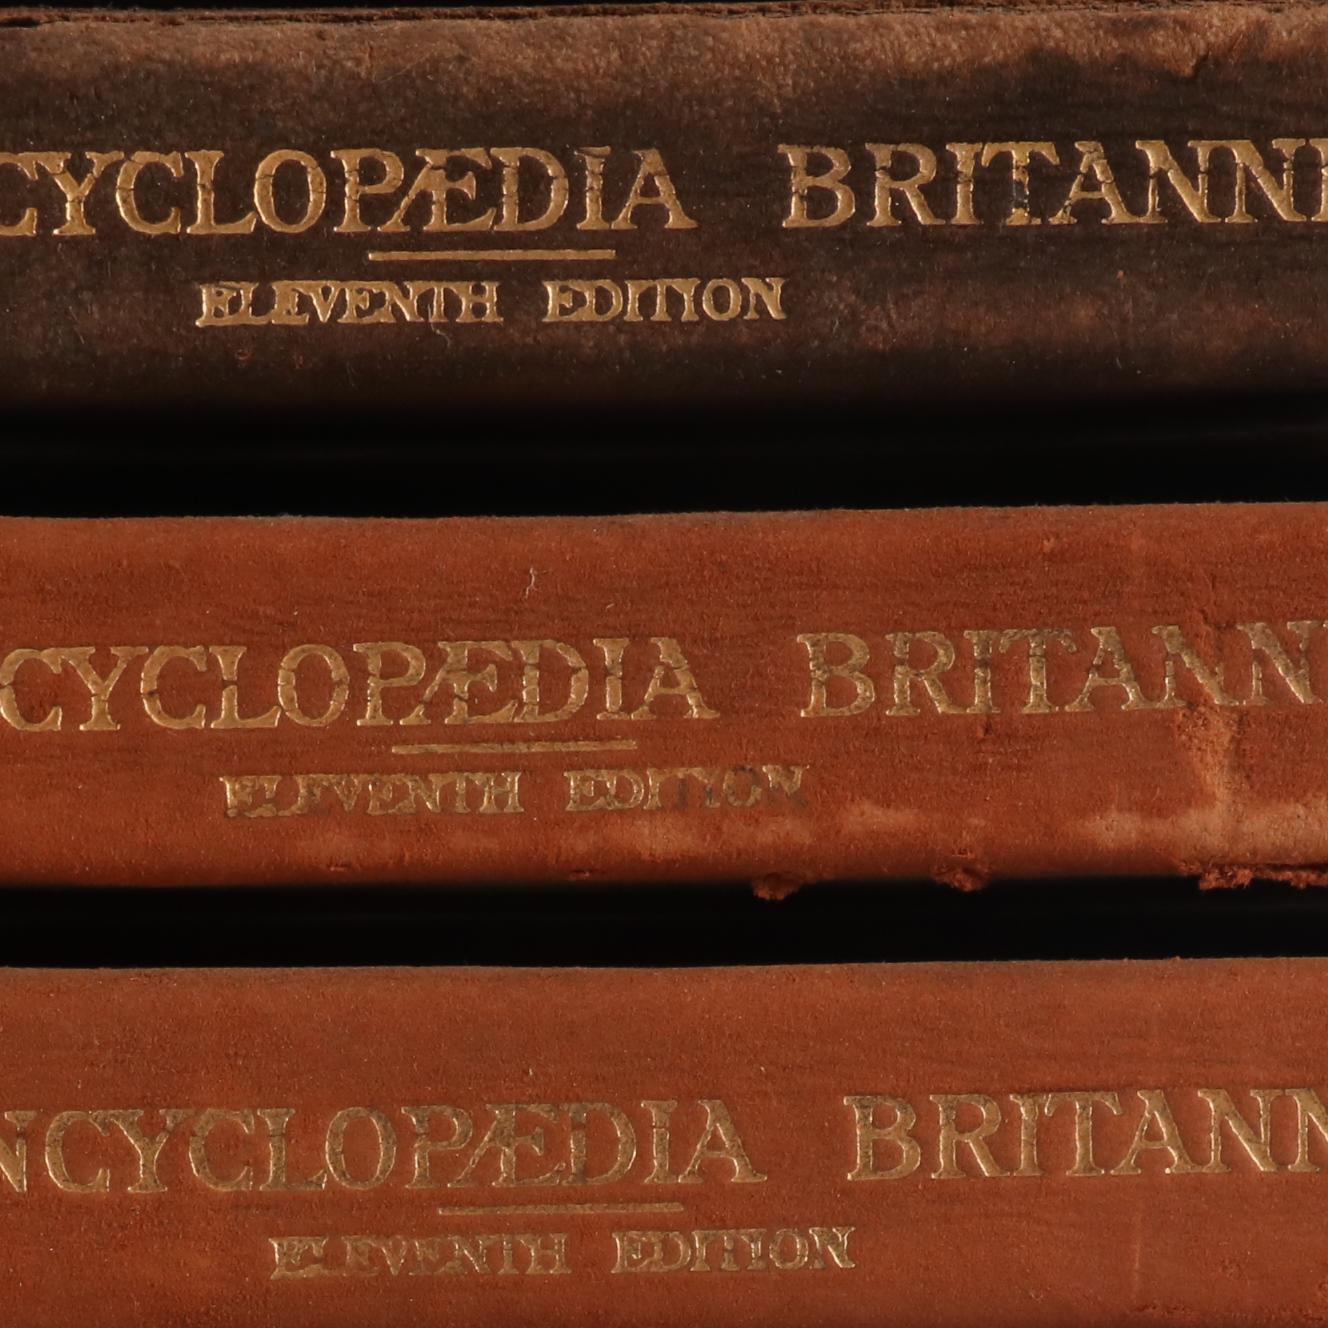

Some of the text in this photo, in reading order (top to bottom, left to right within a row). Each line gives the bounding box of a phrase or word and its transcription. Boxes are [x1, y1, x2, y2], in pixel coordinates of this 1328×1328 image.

[197, 276, 787, 328] ELEVENTH EDITION
[219, 763, 812, 818] ELEVENTH EDITION
[269, 1226, 856, 1279] ELEVENTH EDITION
